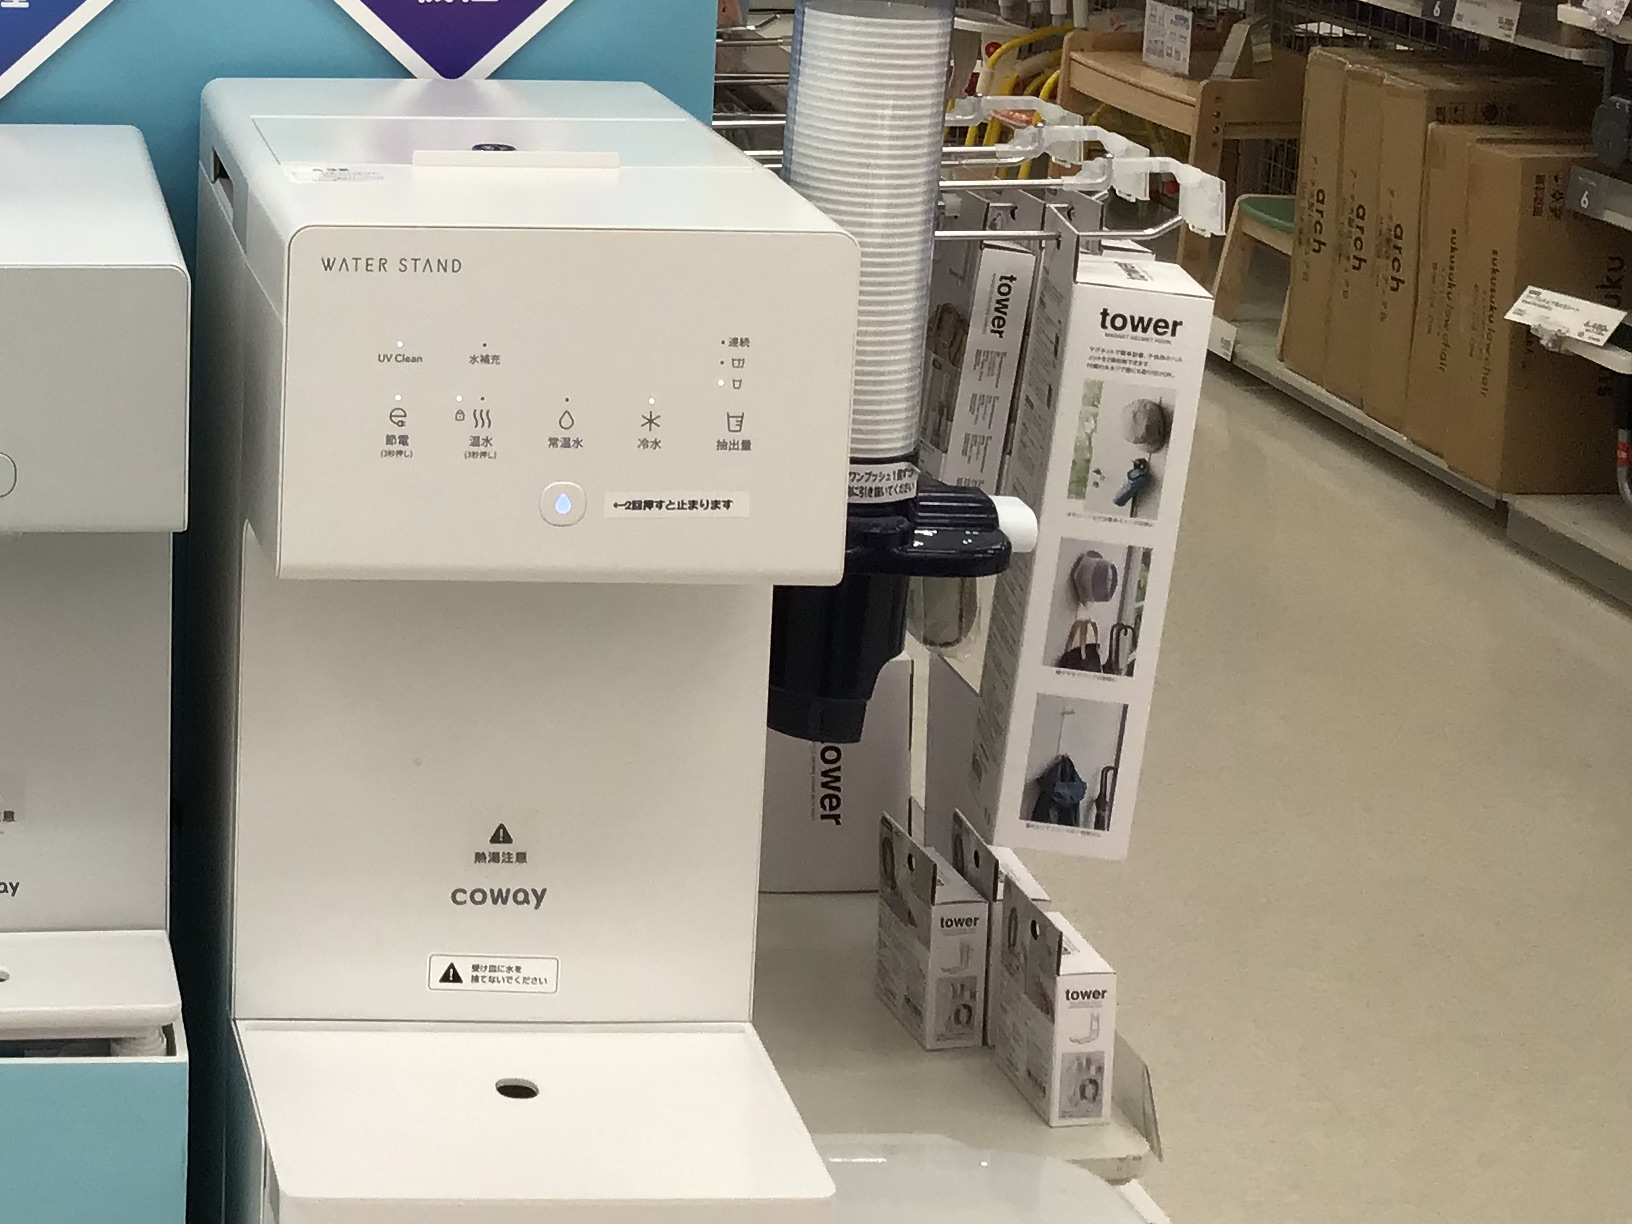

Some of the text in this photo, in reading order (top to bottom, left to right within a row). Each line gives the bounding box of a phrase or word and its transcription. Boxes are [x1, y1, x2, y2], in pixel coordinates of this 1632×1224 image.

[1580, 190, 1589, 209] 6
[1312, 188, 1327, 254] arch
[1352, 203, 1367, 272] arch
[1390, 223, 1406, 292] arch
[321, 257, 463, 274] WATER STAND
[990, 275, 1017, 339] tower
[1100, 308, 1183, 338] tower
[728, 337, 750, 348] 連続
[377, 353, 423, 364] UV Clean
[468, 354, 500, 365] 水補充
[385, 434, 409, 446] 節電
[469, 435, 493, 448] 温水
[548, 437, 584, 449] 常温水
[637, 438, 662, 450] 冷水
[716, 439, 752, 452] 抽出量
[820, 742, 843, 826] ower
[474, 851, 528, 865] 熱湯注意
[450, 887, 547, 911] coway
[939, 915, 980, 929] tower
[1065, 988, 1108, 1002] tower
